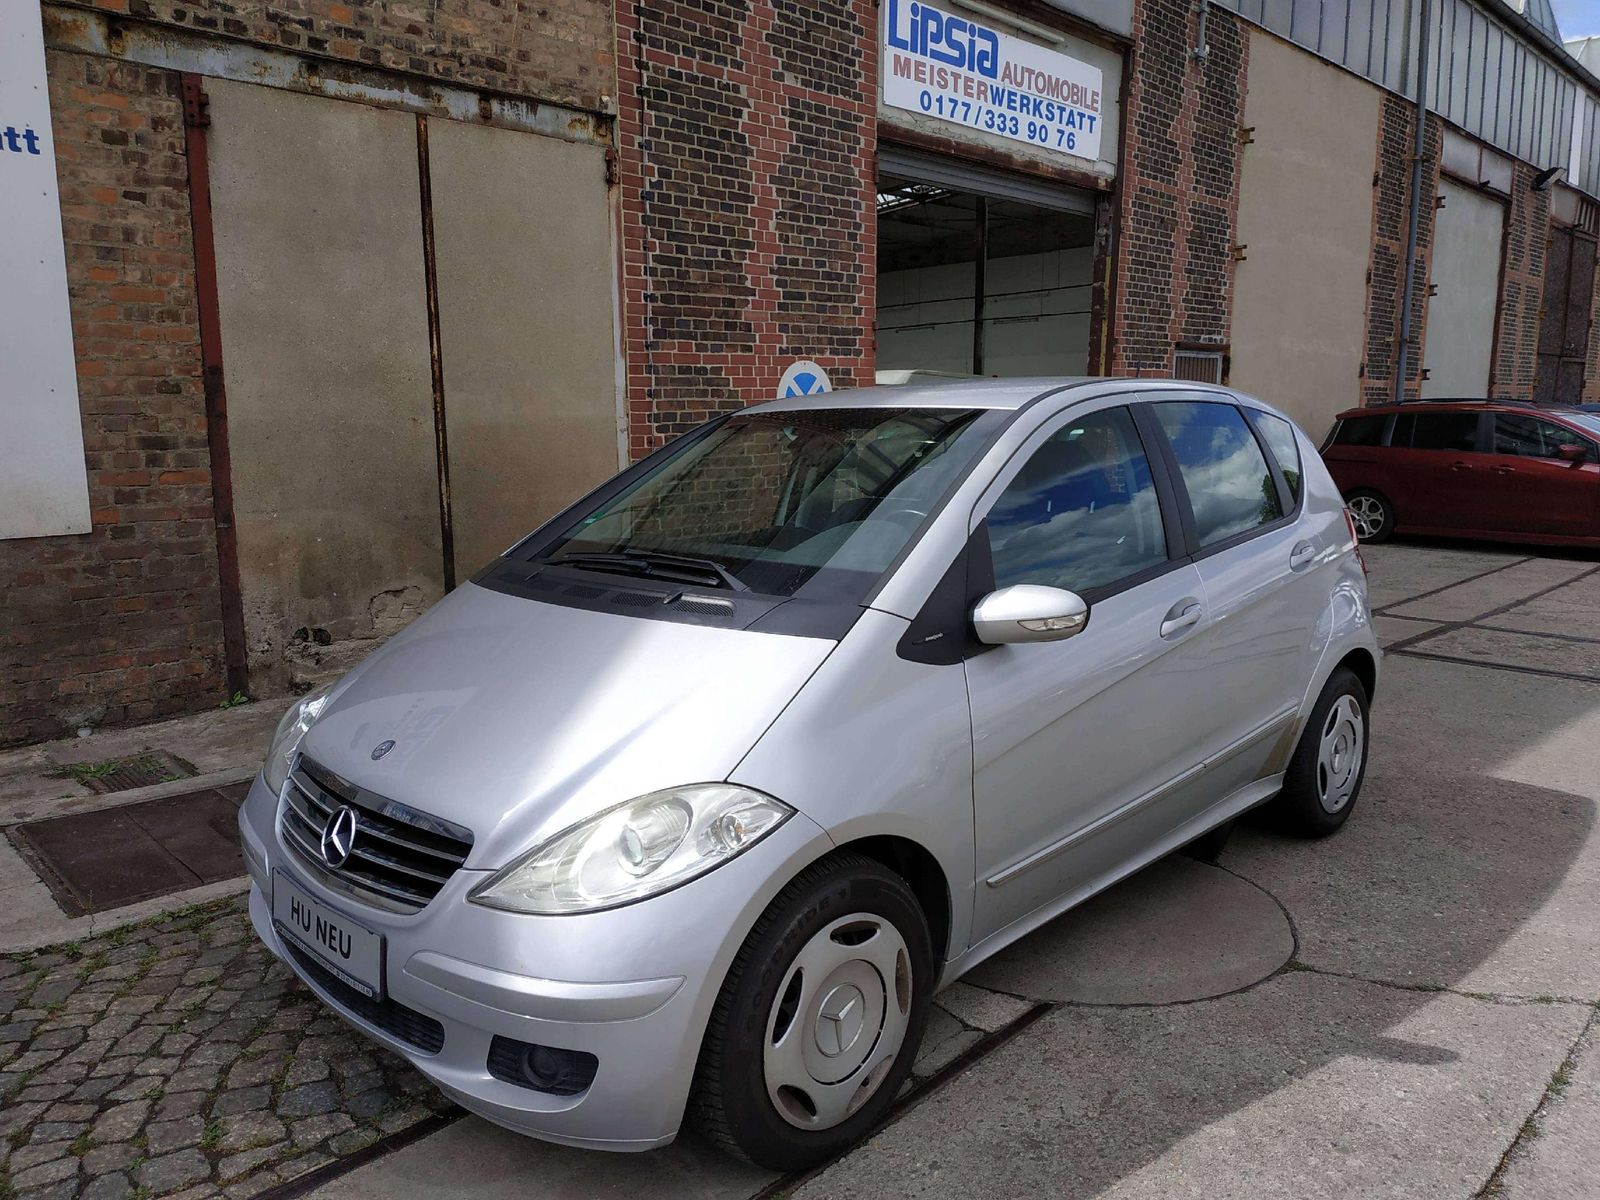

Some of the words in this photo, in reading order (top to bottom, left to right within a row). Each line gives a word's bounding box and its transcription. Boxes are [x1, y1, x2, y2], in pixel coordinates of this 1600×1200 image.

[893, 54, 1097, 134] MEISTERWERKSTATT
[1001, 61, 1099, 112] AUTOMOBILE
[0, 126, 41, 155] tt
[920, 90, 1019, 135] 0177/333
[1027, 121, 1048, 142] 90
[1056, 128, 1076, 150] 76
[291, 896, 310, 932] HU
[316, 915, 351, 959] NEU
